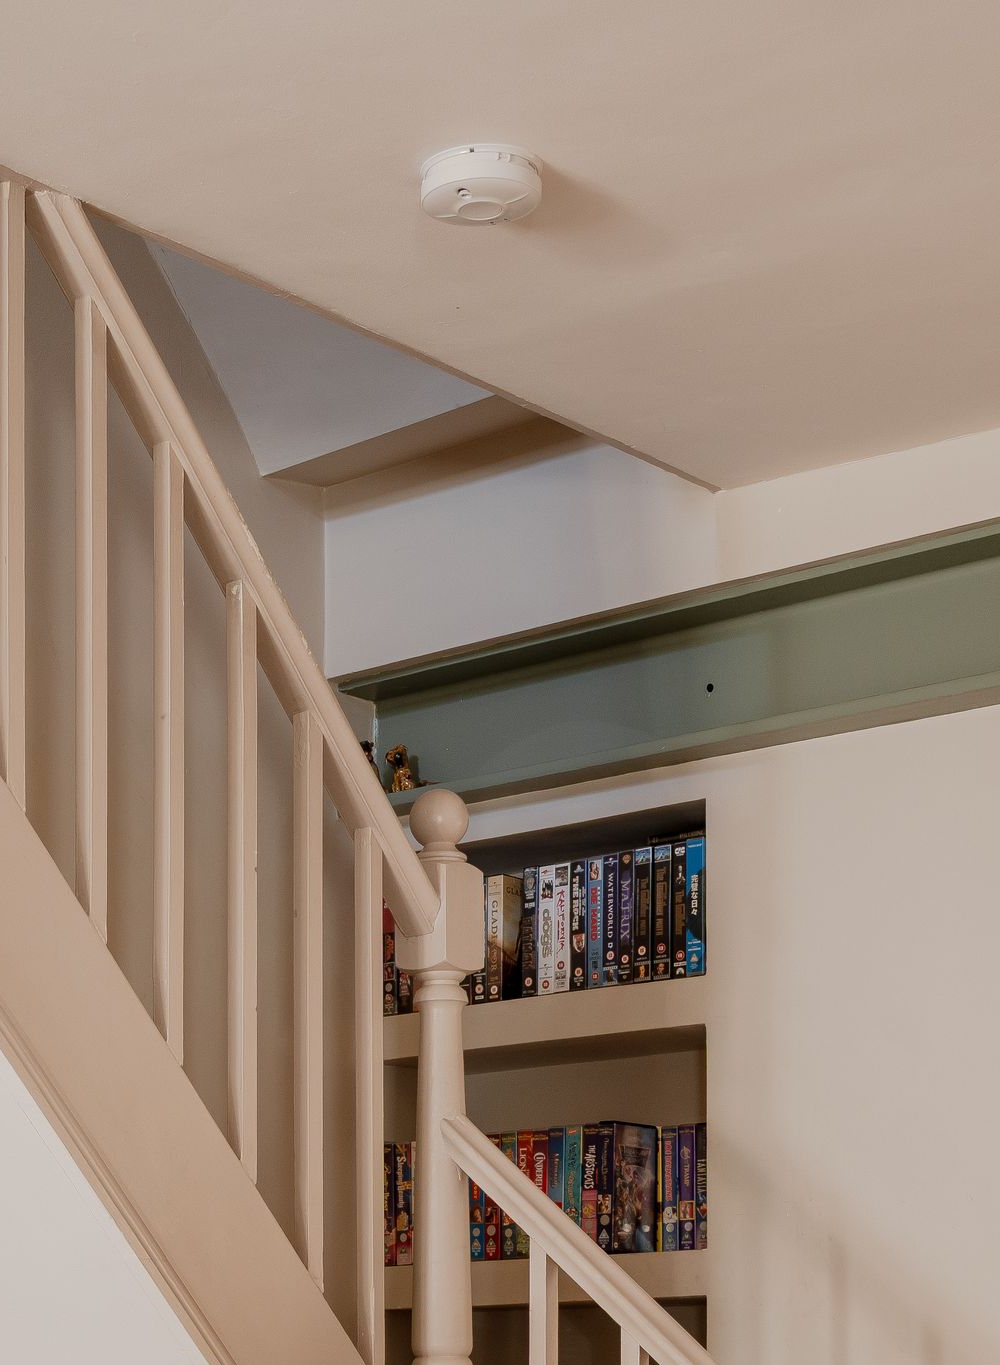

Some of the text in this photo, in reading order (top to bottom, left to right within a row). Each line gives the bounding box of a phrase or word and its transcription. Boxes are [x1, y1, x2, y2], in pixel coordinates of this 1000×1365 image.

[590, 886, 598, 904] DIE
[620, 879, 631, 939] MATRIX
[491, 900, 499, 973] GLADIATOR
[590, 909, 598, 941] HARD
[519, 1148, 527, 1172] LION
[697, 1159, 707, 1193] FANTASIA
